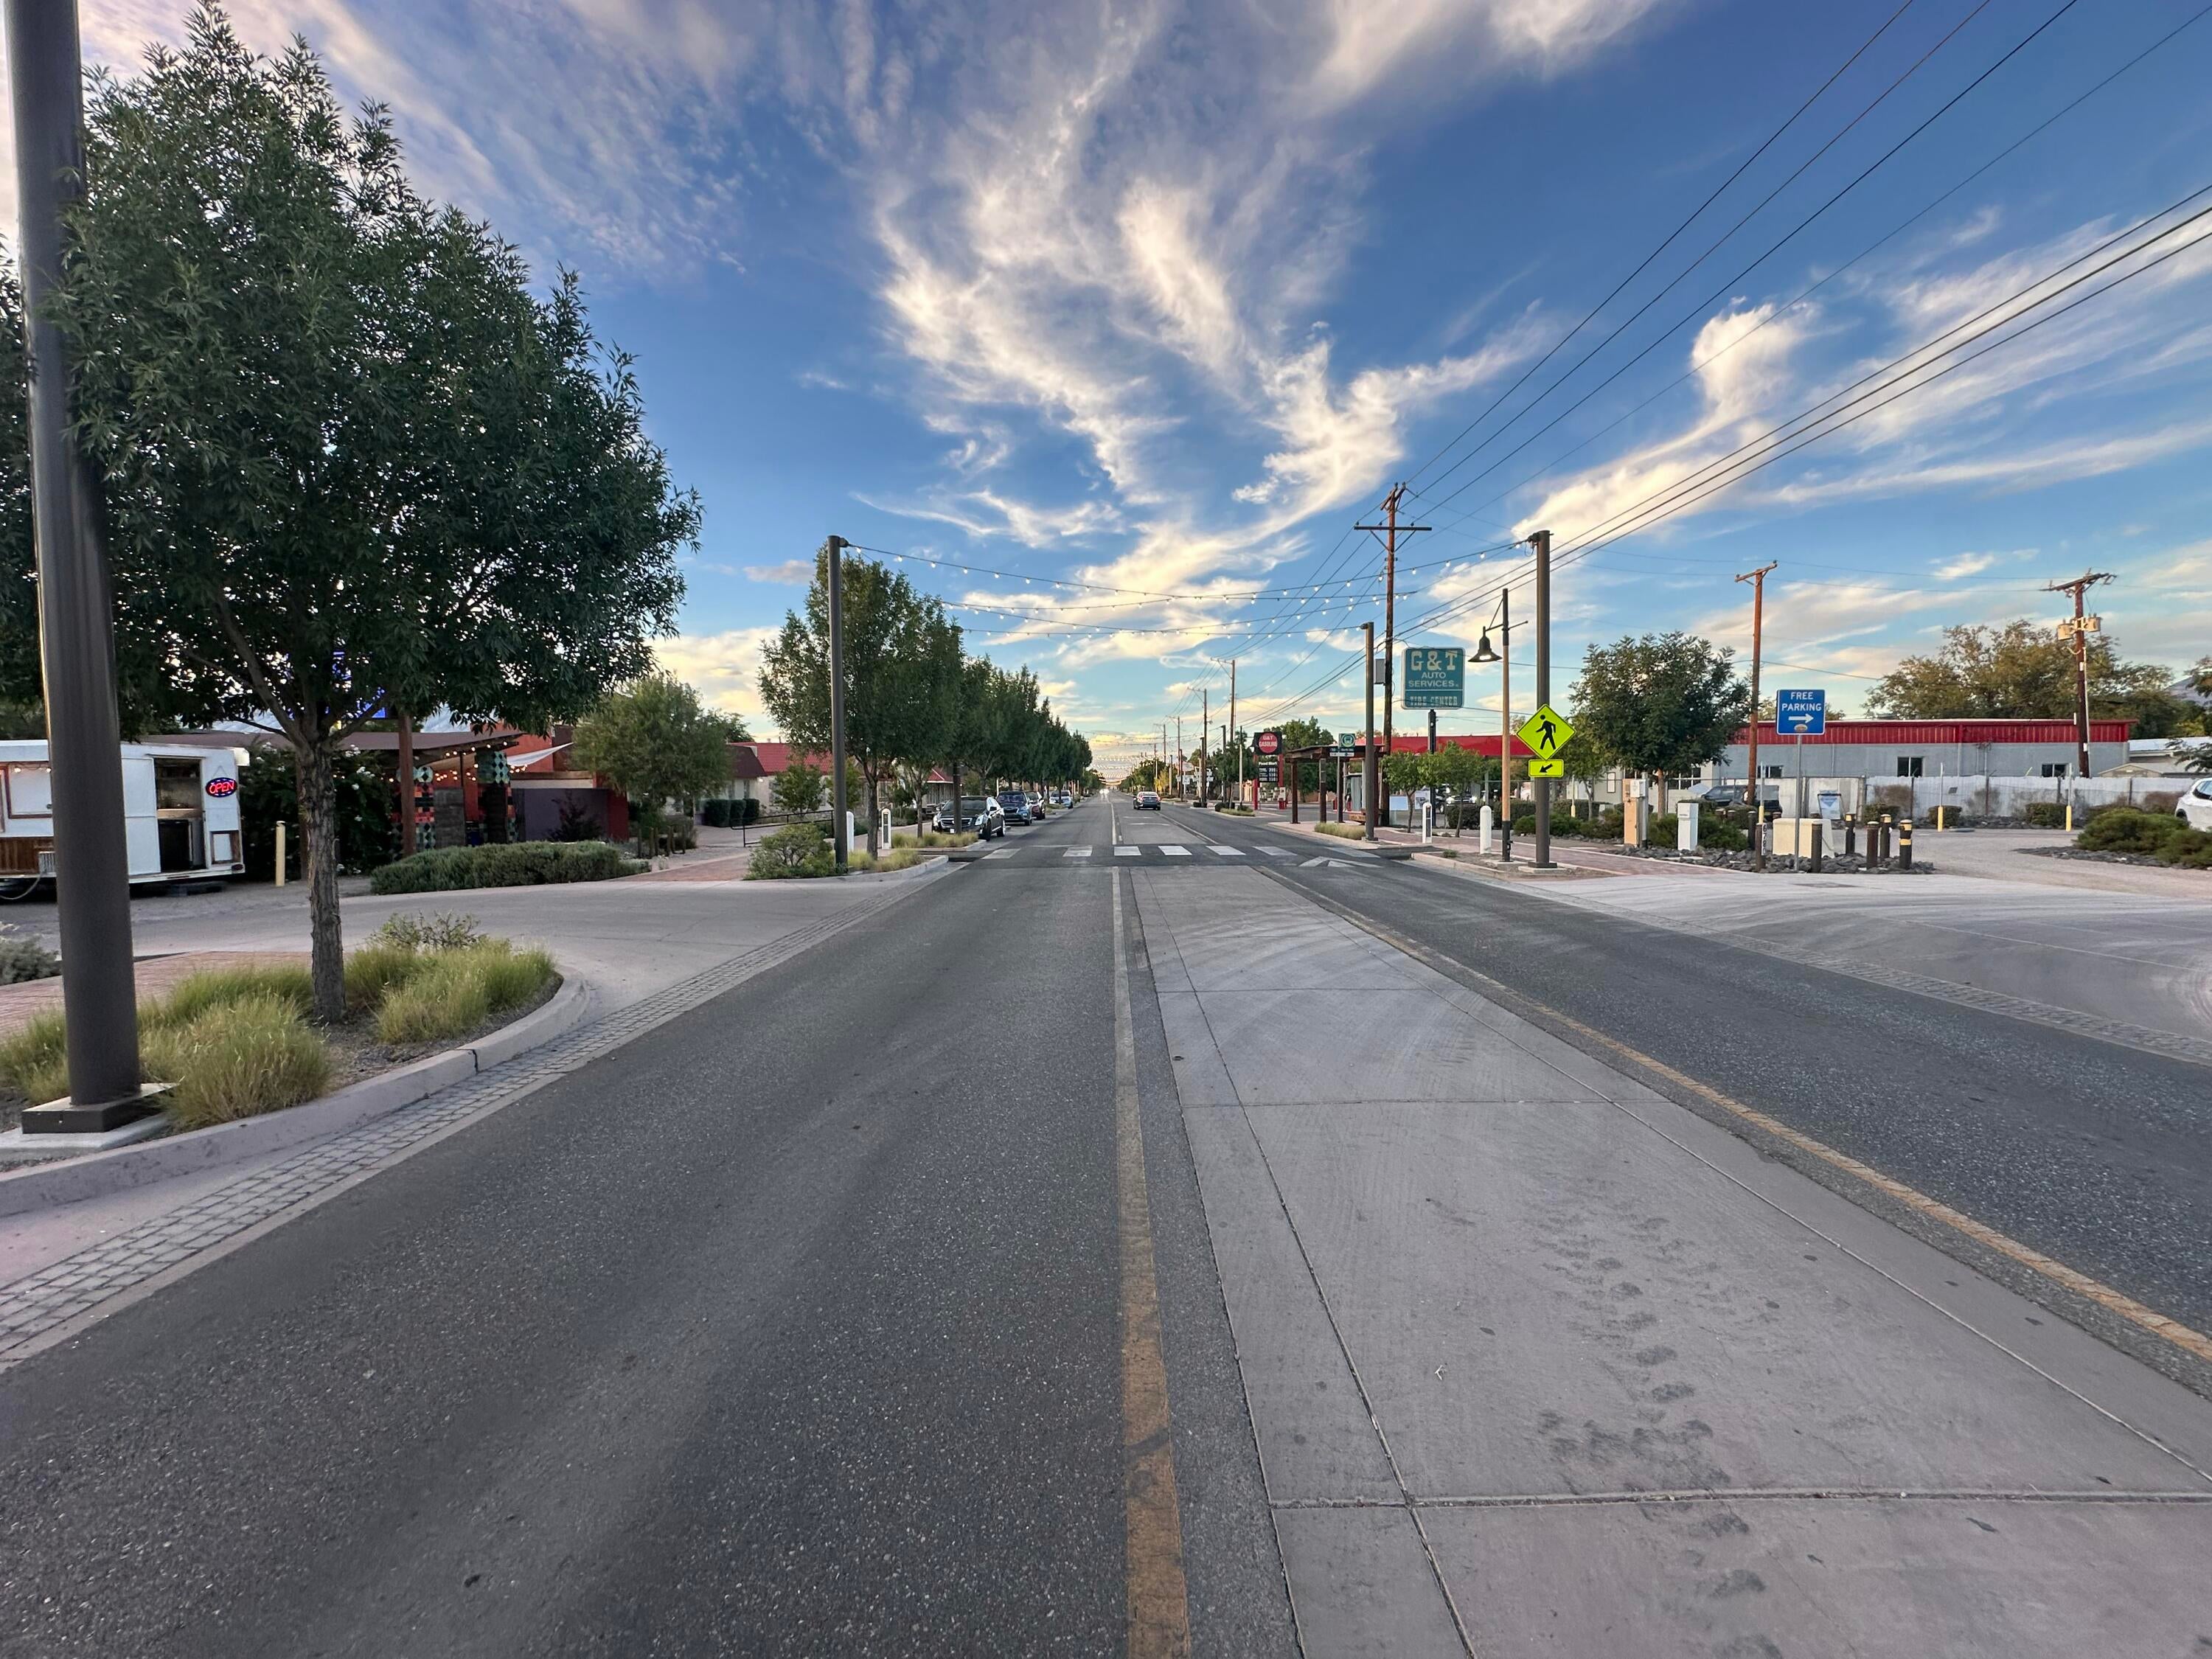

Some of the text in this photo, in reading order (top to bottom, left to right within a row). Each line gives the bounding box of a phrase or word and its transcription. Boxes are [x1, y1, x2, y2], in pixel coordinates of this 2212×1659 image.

[1790, 692, 1814, 700] FREE
[1410, 696, 1458, 706] TIRE CENTER
[1781, 703, 1822, 712] PARKING
[209, 781, 234, 794] OPEN
